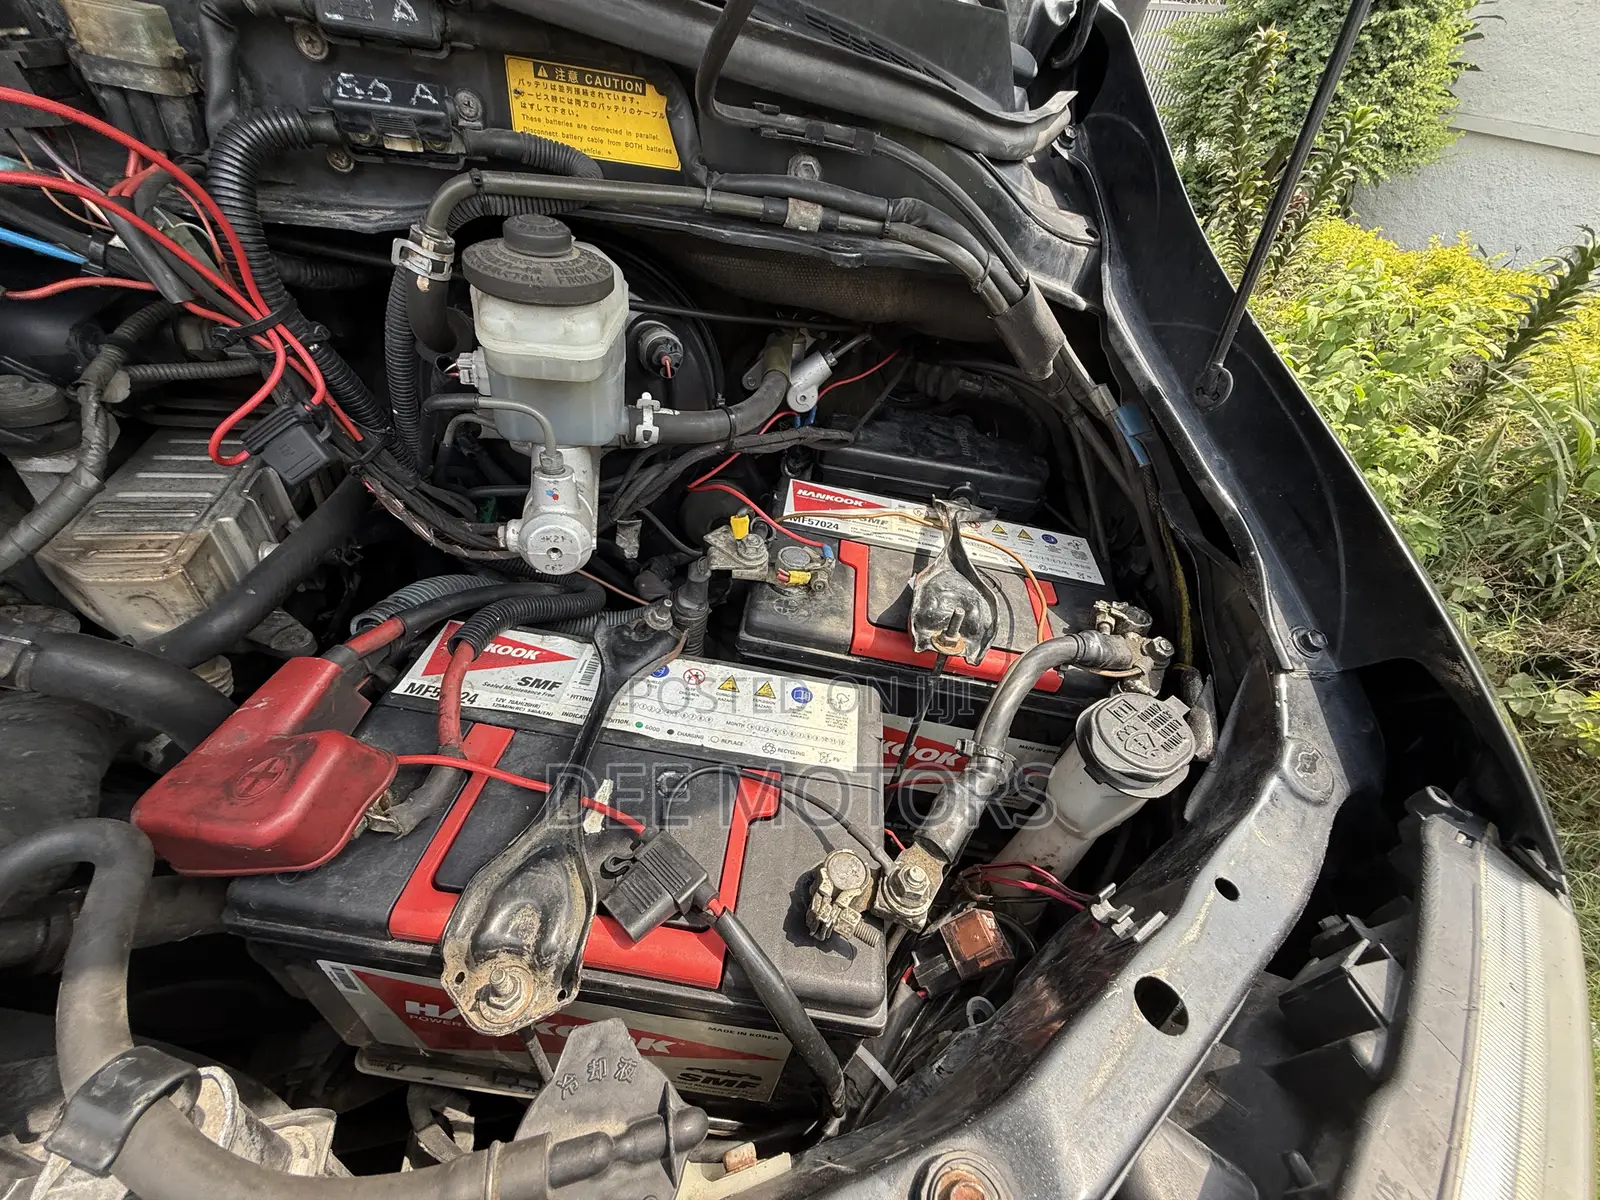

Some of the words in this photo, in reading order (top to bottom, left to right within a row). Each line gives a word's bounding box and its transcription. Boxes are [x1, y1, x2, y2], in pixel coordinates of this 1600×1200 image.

[555, 67, 578, 83] 注意
[585, 74, 643, 93] CAUTION
[521, 113, 541, 123] These
[545, 118, 573, 128] batteries
[591, 125, 623, 135] connected
[636, 132, 660, 140] parallel.
[523, 126, 558, 137] Disconnect
[561, 132, 584, 142] battery
[587, 136, 604, 144] cable
[607, 138, 621, 147] from
[625, 141, 643, 150] BOTH
[646, 145, 672, 155] batteries
[797, 488, 865, 507] HANKOOK
[483, 681, 503, 690] Sealed
[504, 685, 541, 695] Maintenance
[517, 676, 563, 691] SMF
[404, 682, 479, 705] MF524
[570, 693, 594, 703] FITTING
[561, 711, 588, 720] INDICAT
[645, 725, 660, 733] GOOD
[677, 731, 704, 740] CHARGING
[721, 738, 744, 747] REPLACE
[777, 747, 805, 757] RECYCLING
[409, 1014, 462, 1027] POWER
[708, 1026, 735, 1035] MADE
[749, 1032, 779, 1041] KOREA
[556, 1056, 637, 1100] 冷却液
[677, 1071, 762, 1089] SMF
